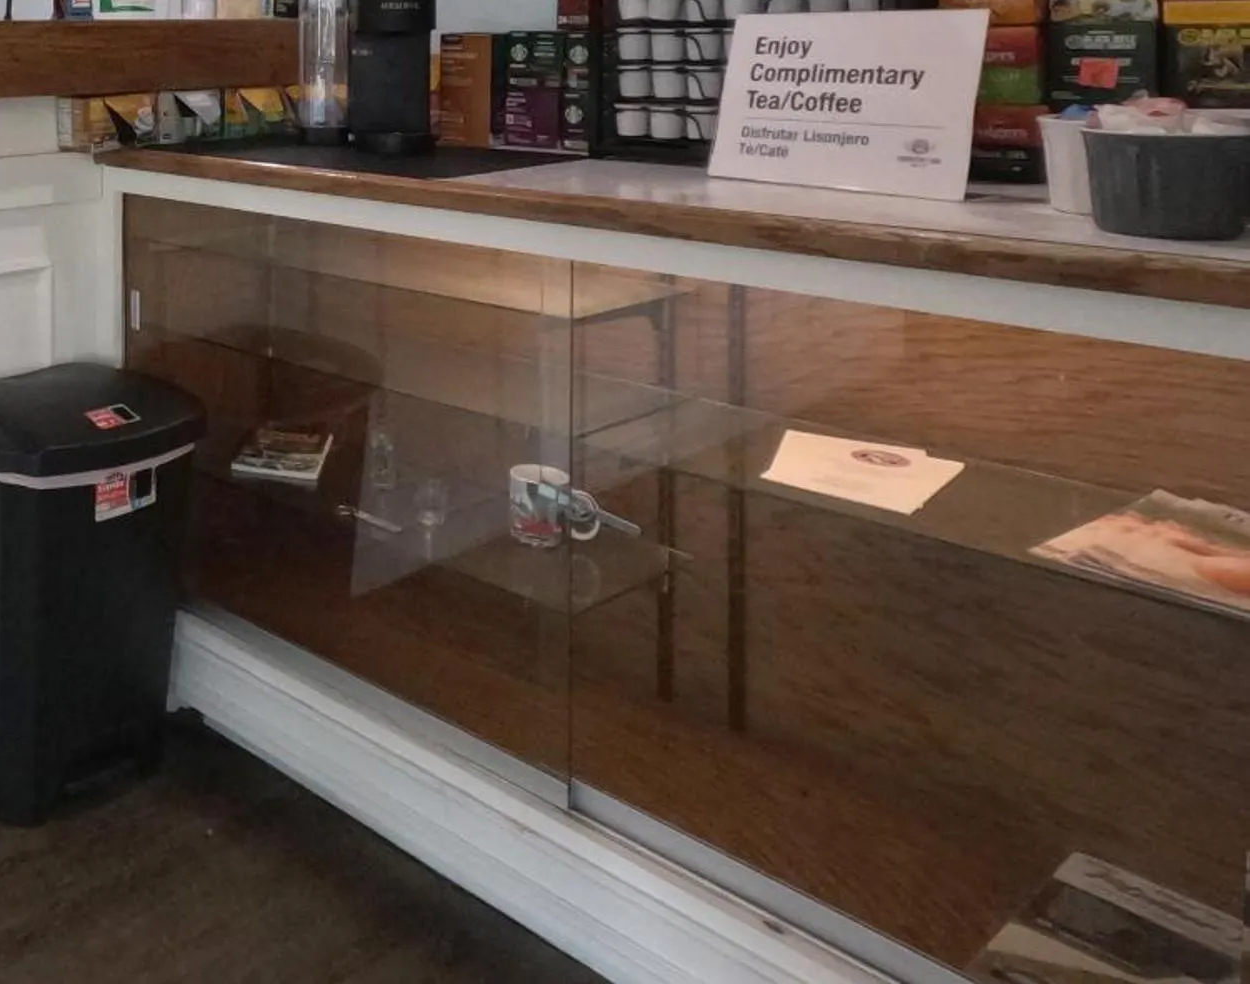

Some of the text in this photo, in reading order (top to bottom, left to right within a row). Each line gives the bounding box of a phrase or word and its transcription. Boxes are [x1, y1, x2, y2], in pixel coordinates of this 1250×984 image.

[755, 37, 812, 58] Enjoy
[750, 63, 925, 90] Complimentary
[747, 90, 862, 114] Tea/Coffee
[741, 125, 798, 141] Disfrutar
